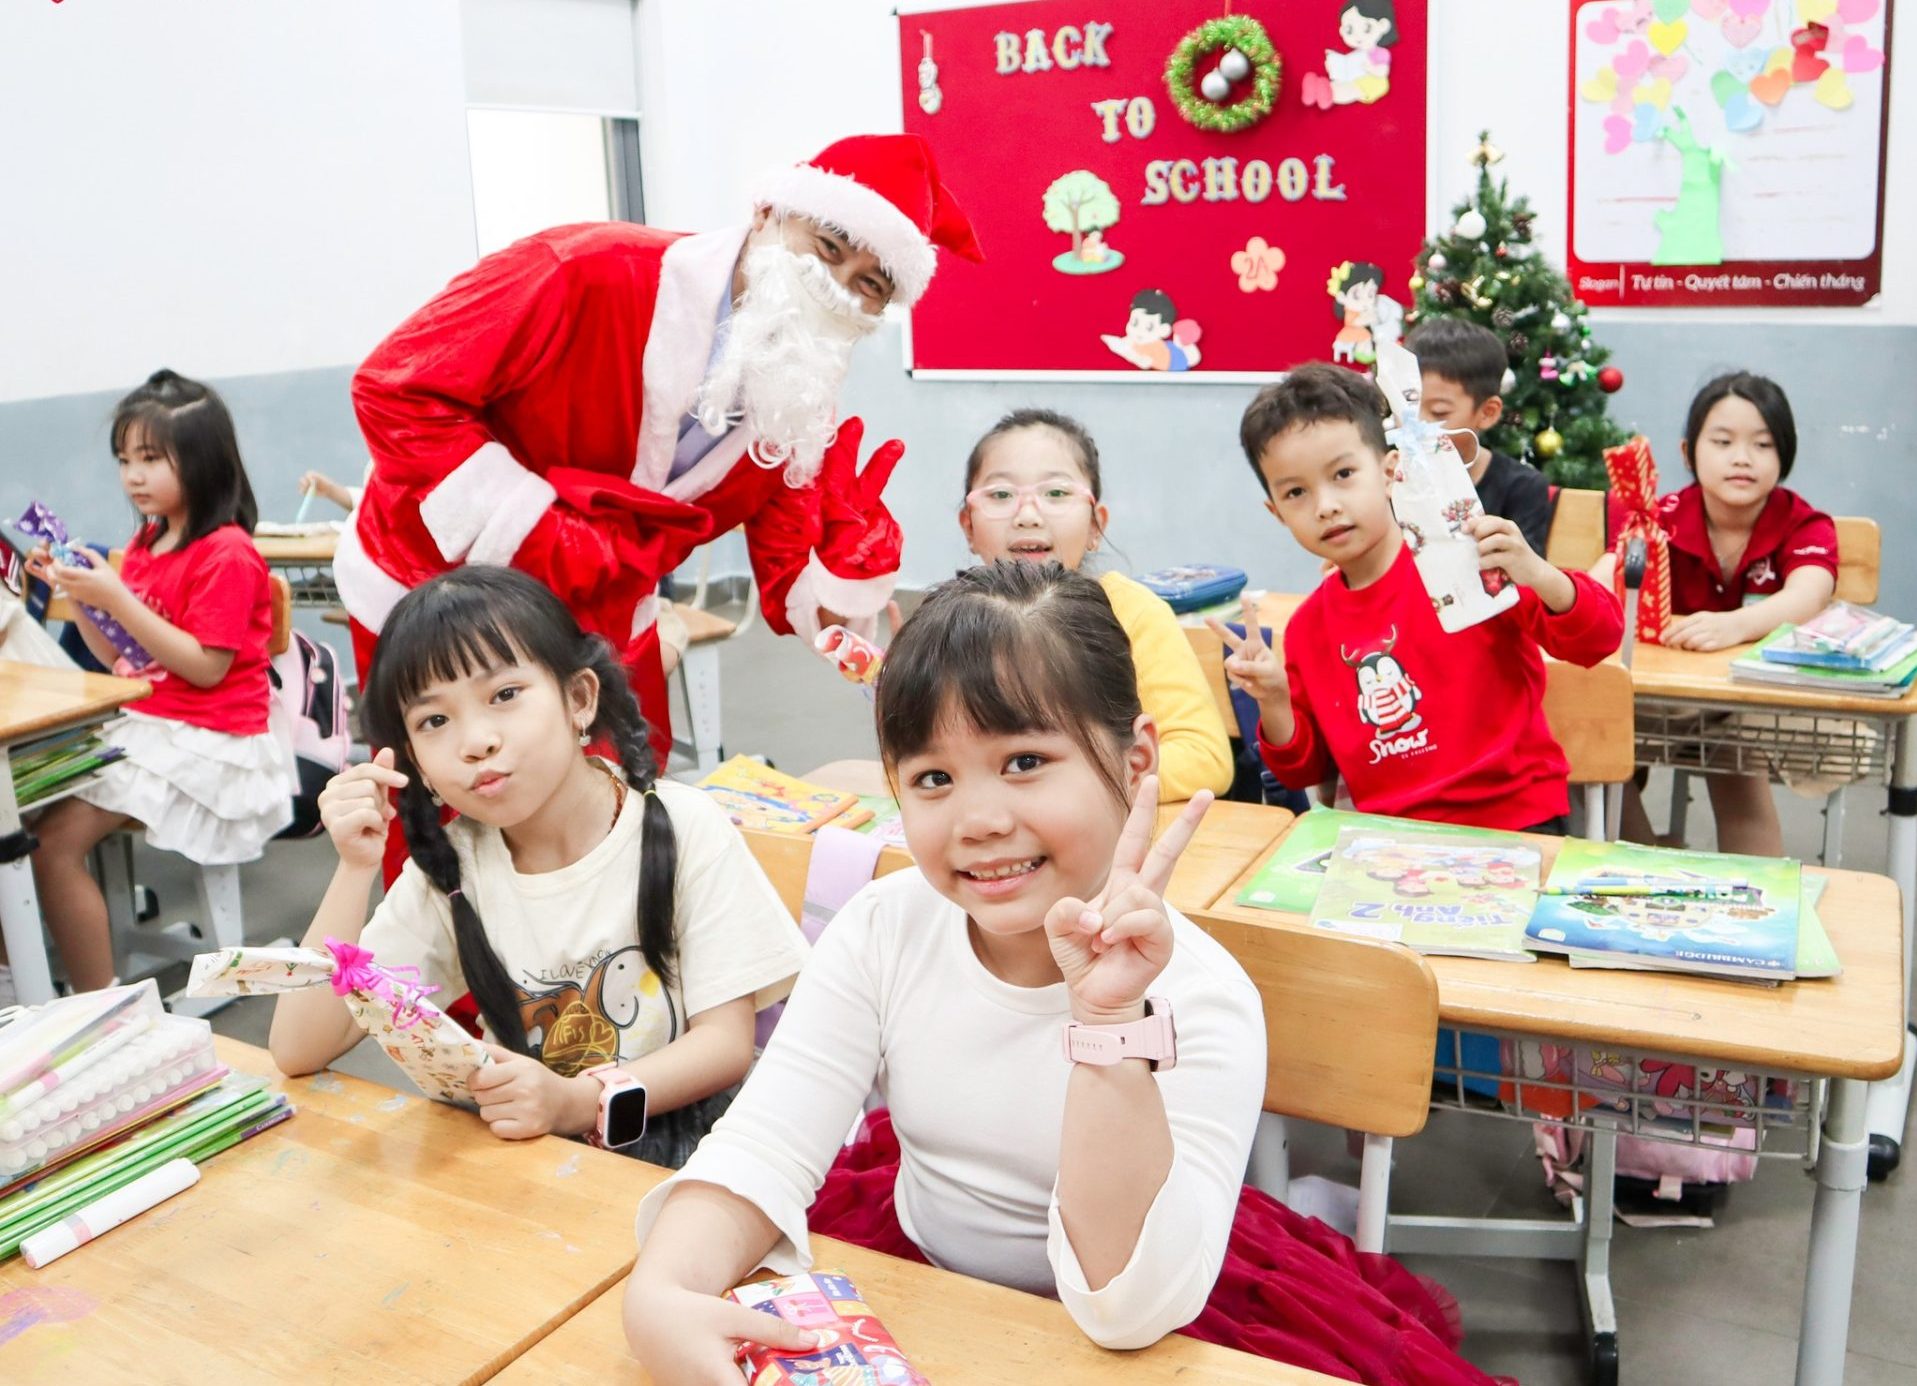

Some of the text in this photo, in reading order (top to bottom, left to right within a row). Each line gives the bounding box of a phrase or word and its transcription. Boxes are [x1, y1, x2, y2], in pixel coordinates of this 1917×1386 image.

[993, 20, 1113, 74] BACK
[1090, 96, 1156, 143] TO
[1141, 153, 1347, 205] SCHOOL
[1369, 728, 1428, 764] Snow
[1349, 901, 1386, 919] 2
[550, 963, 585, 980] LOVE
[1675, 950, 1765, 967] CAMBRIDGE
